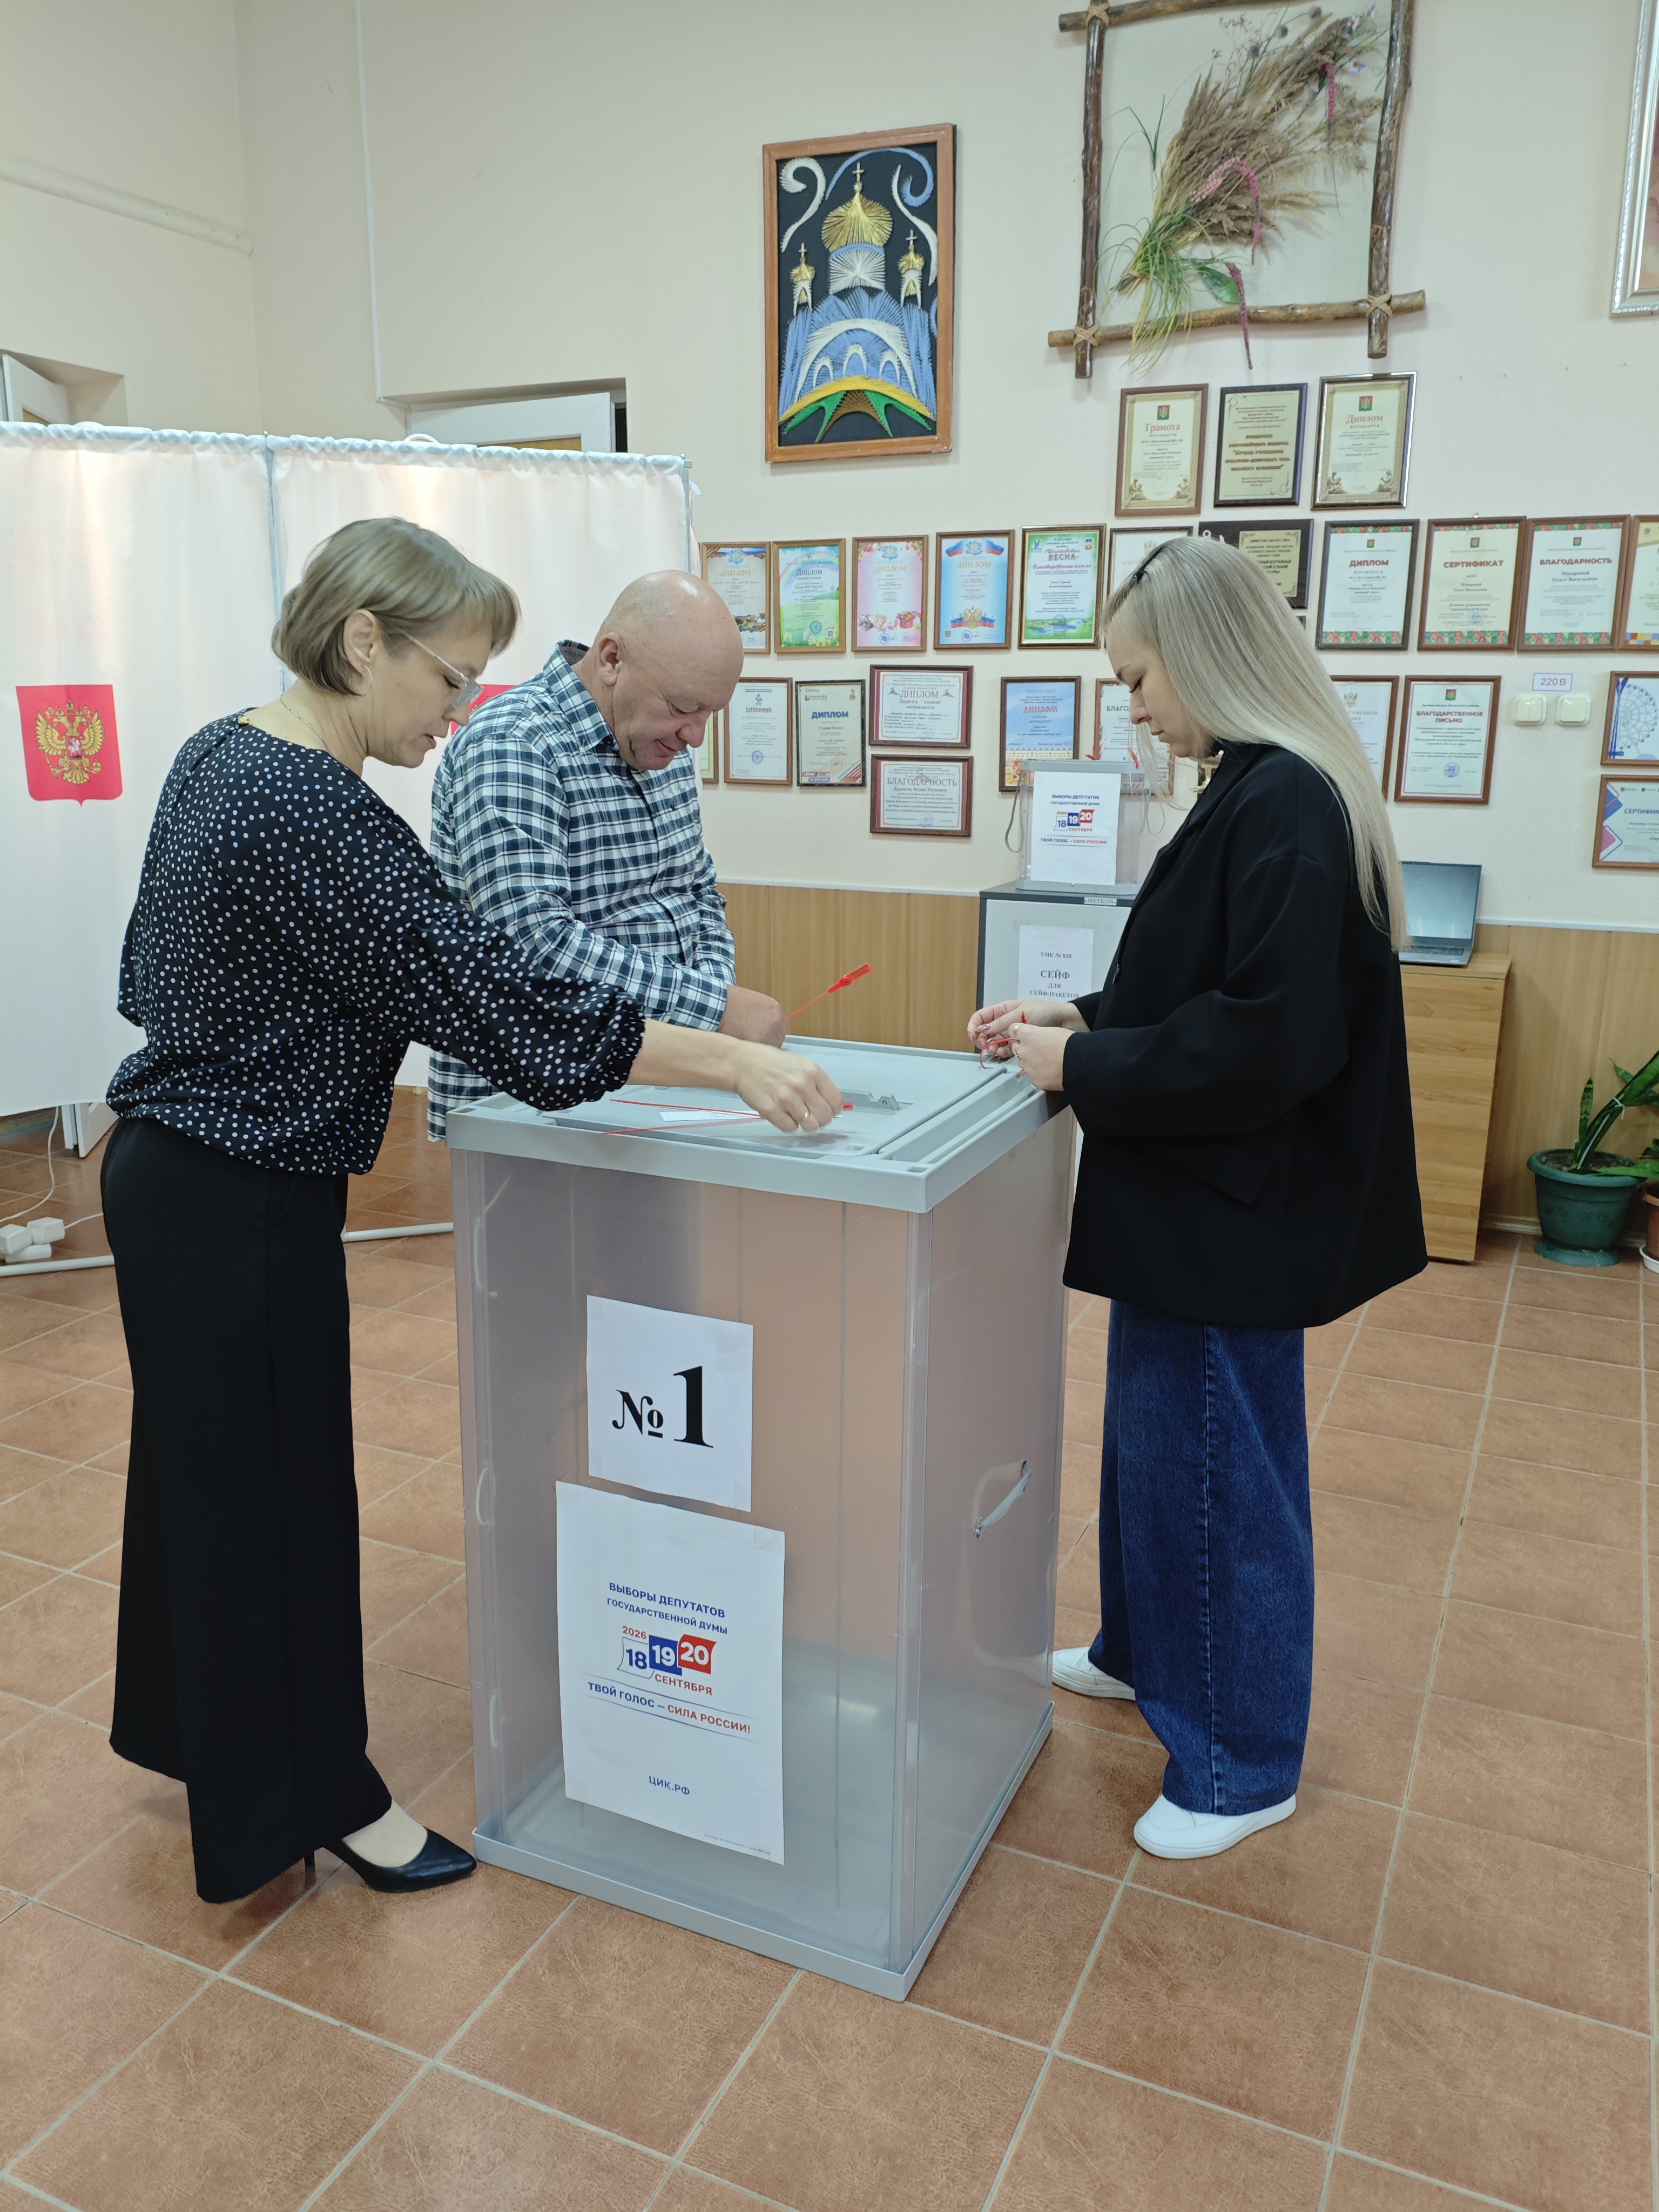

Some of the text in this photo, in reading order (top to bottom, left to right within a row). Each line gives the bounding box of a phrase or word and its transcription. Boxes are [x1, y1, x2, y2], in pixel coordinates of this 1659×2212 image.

[1346, 415, 1383, 424] Диплом
[1145, 423, 1180, 433] Грамота
[1540, 678, 1558, 686] 220
[900, 690, 939, 698] ДИПЛОМ
[811, 711, 849, 719] ДИПЛОМ
[1023, 706, 1057, 714] ДИПЛОМ
[887, 778, 957, 786] БЛАГОДАРНОСТЬ
[1069, 815, 1078, 824] 19
[1080, 812, 1092, 821] 20
[1041, 969, 1070, 979] СЕЙФ
[1030, 990, 1079, 999] СЕЙФ-ПАКЕТОВ
[612, 1366, 713, 1448] № 1
[609, 1582, 725, 1618] ВЫБОРЫ ДЕПУТАТОВ
[607, 1598, 727, 1634] ГОСУДАРСТВЕННОЙ ДУМЫ
[622, 1626, 647, 1640] 2026
[626, 1642, 709, 1670] 18 19 20
[655, 1674, 712, 1696] СЕНТЯБРЯ
[588, 1682, 616, 1697] ТВОЙ
[619, 1690, 655, 1708] ГОЛОС
[667, 1704, 697, 1720] СИЛА
[700, 1713, 750, 1734] РОССИИ!
[649, 1775, 690, 1796] ЦИК.РФ
